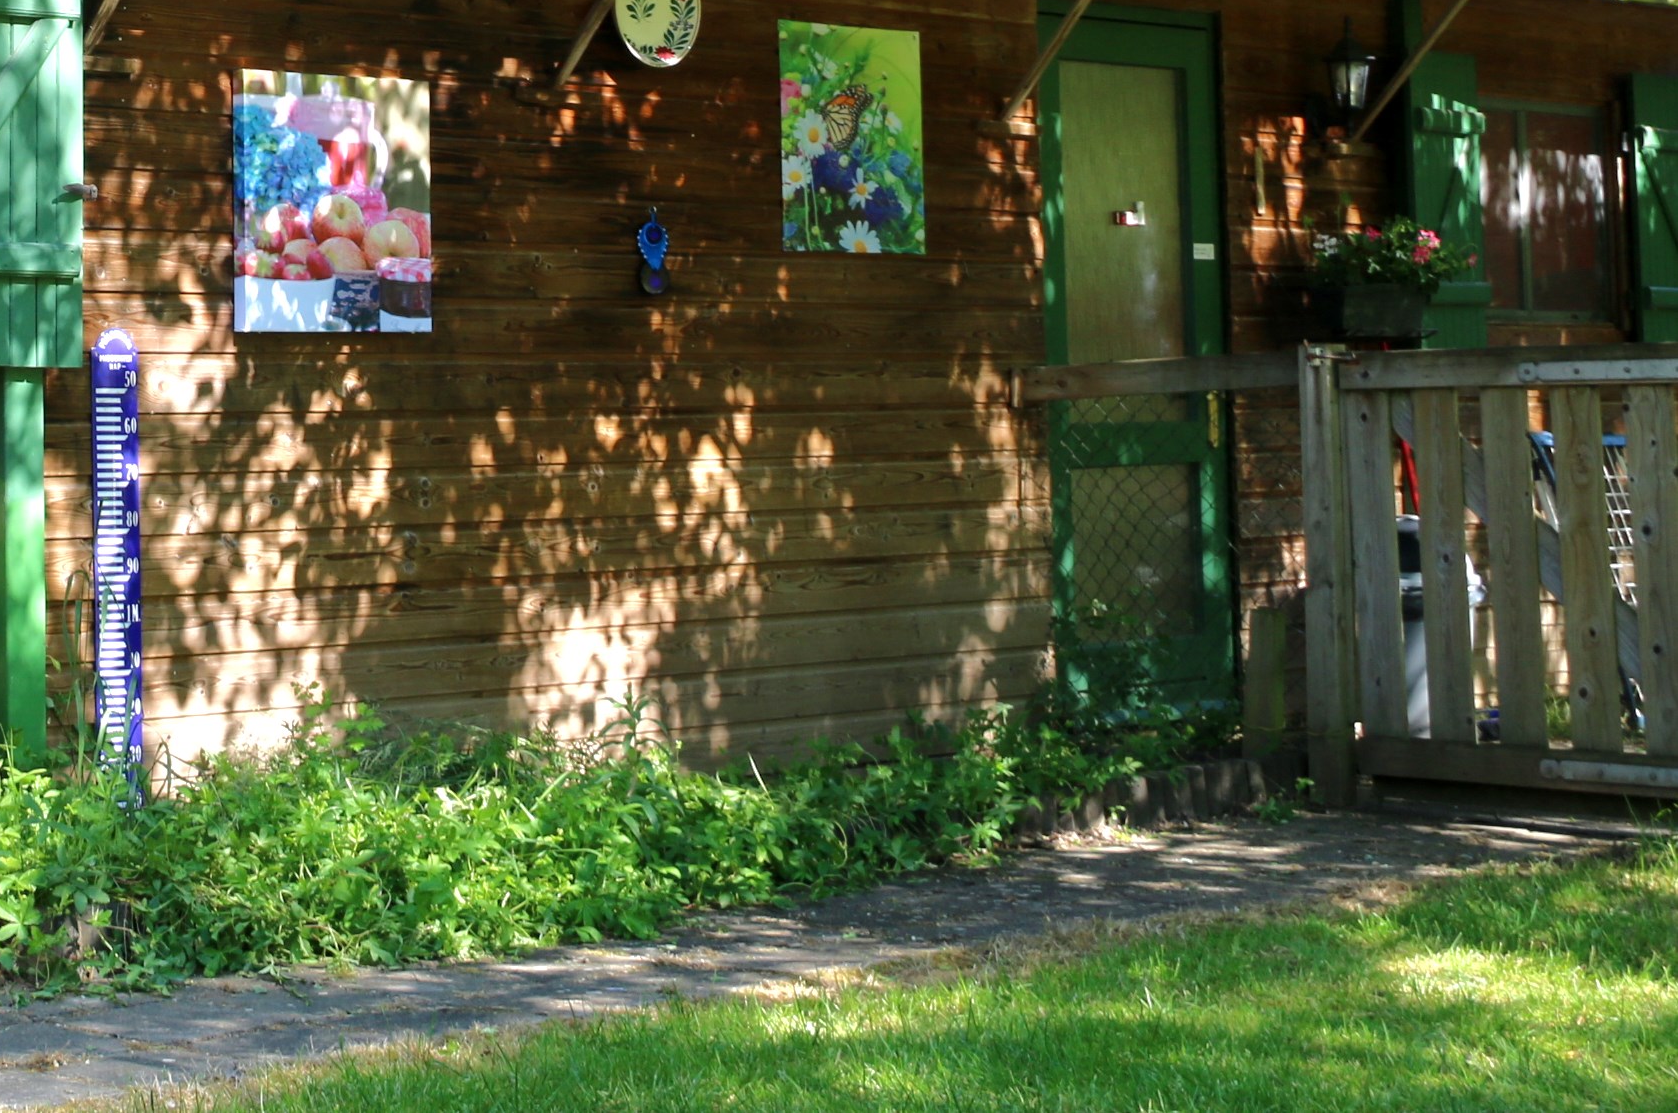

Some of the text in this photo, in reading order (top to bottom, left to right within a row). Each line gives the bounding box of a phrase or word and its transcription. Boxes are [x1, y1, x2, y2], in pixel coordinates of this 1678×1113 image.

[124, 371, 137, 388] 50
[124, 418, 137, 434] 60
[125, 464, 139, 481] 70
[126, 511, 138, 527] 80
[126, 558, 139, 573] 90
[129, 744, 141, 762] 30
